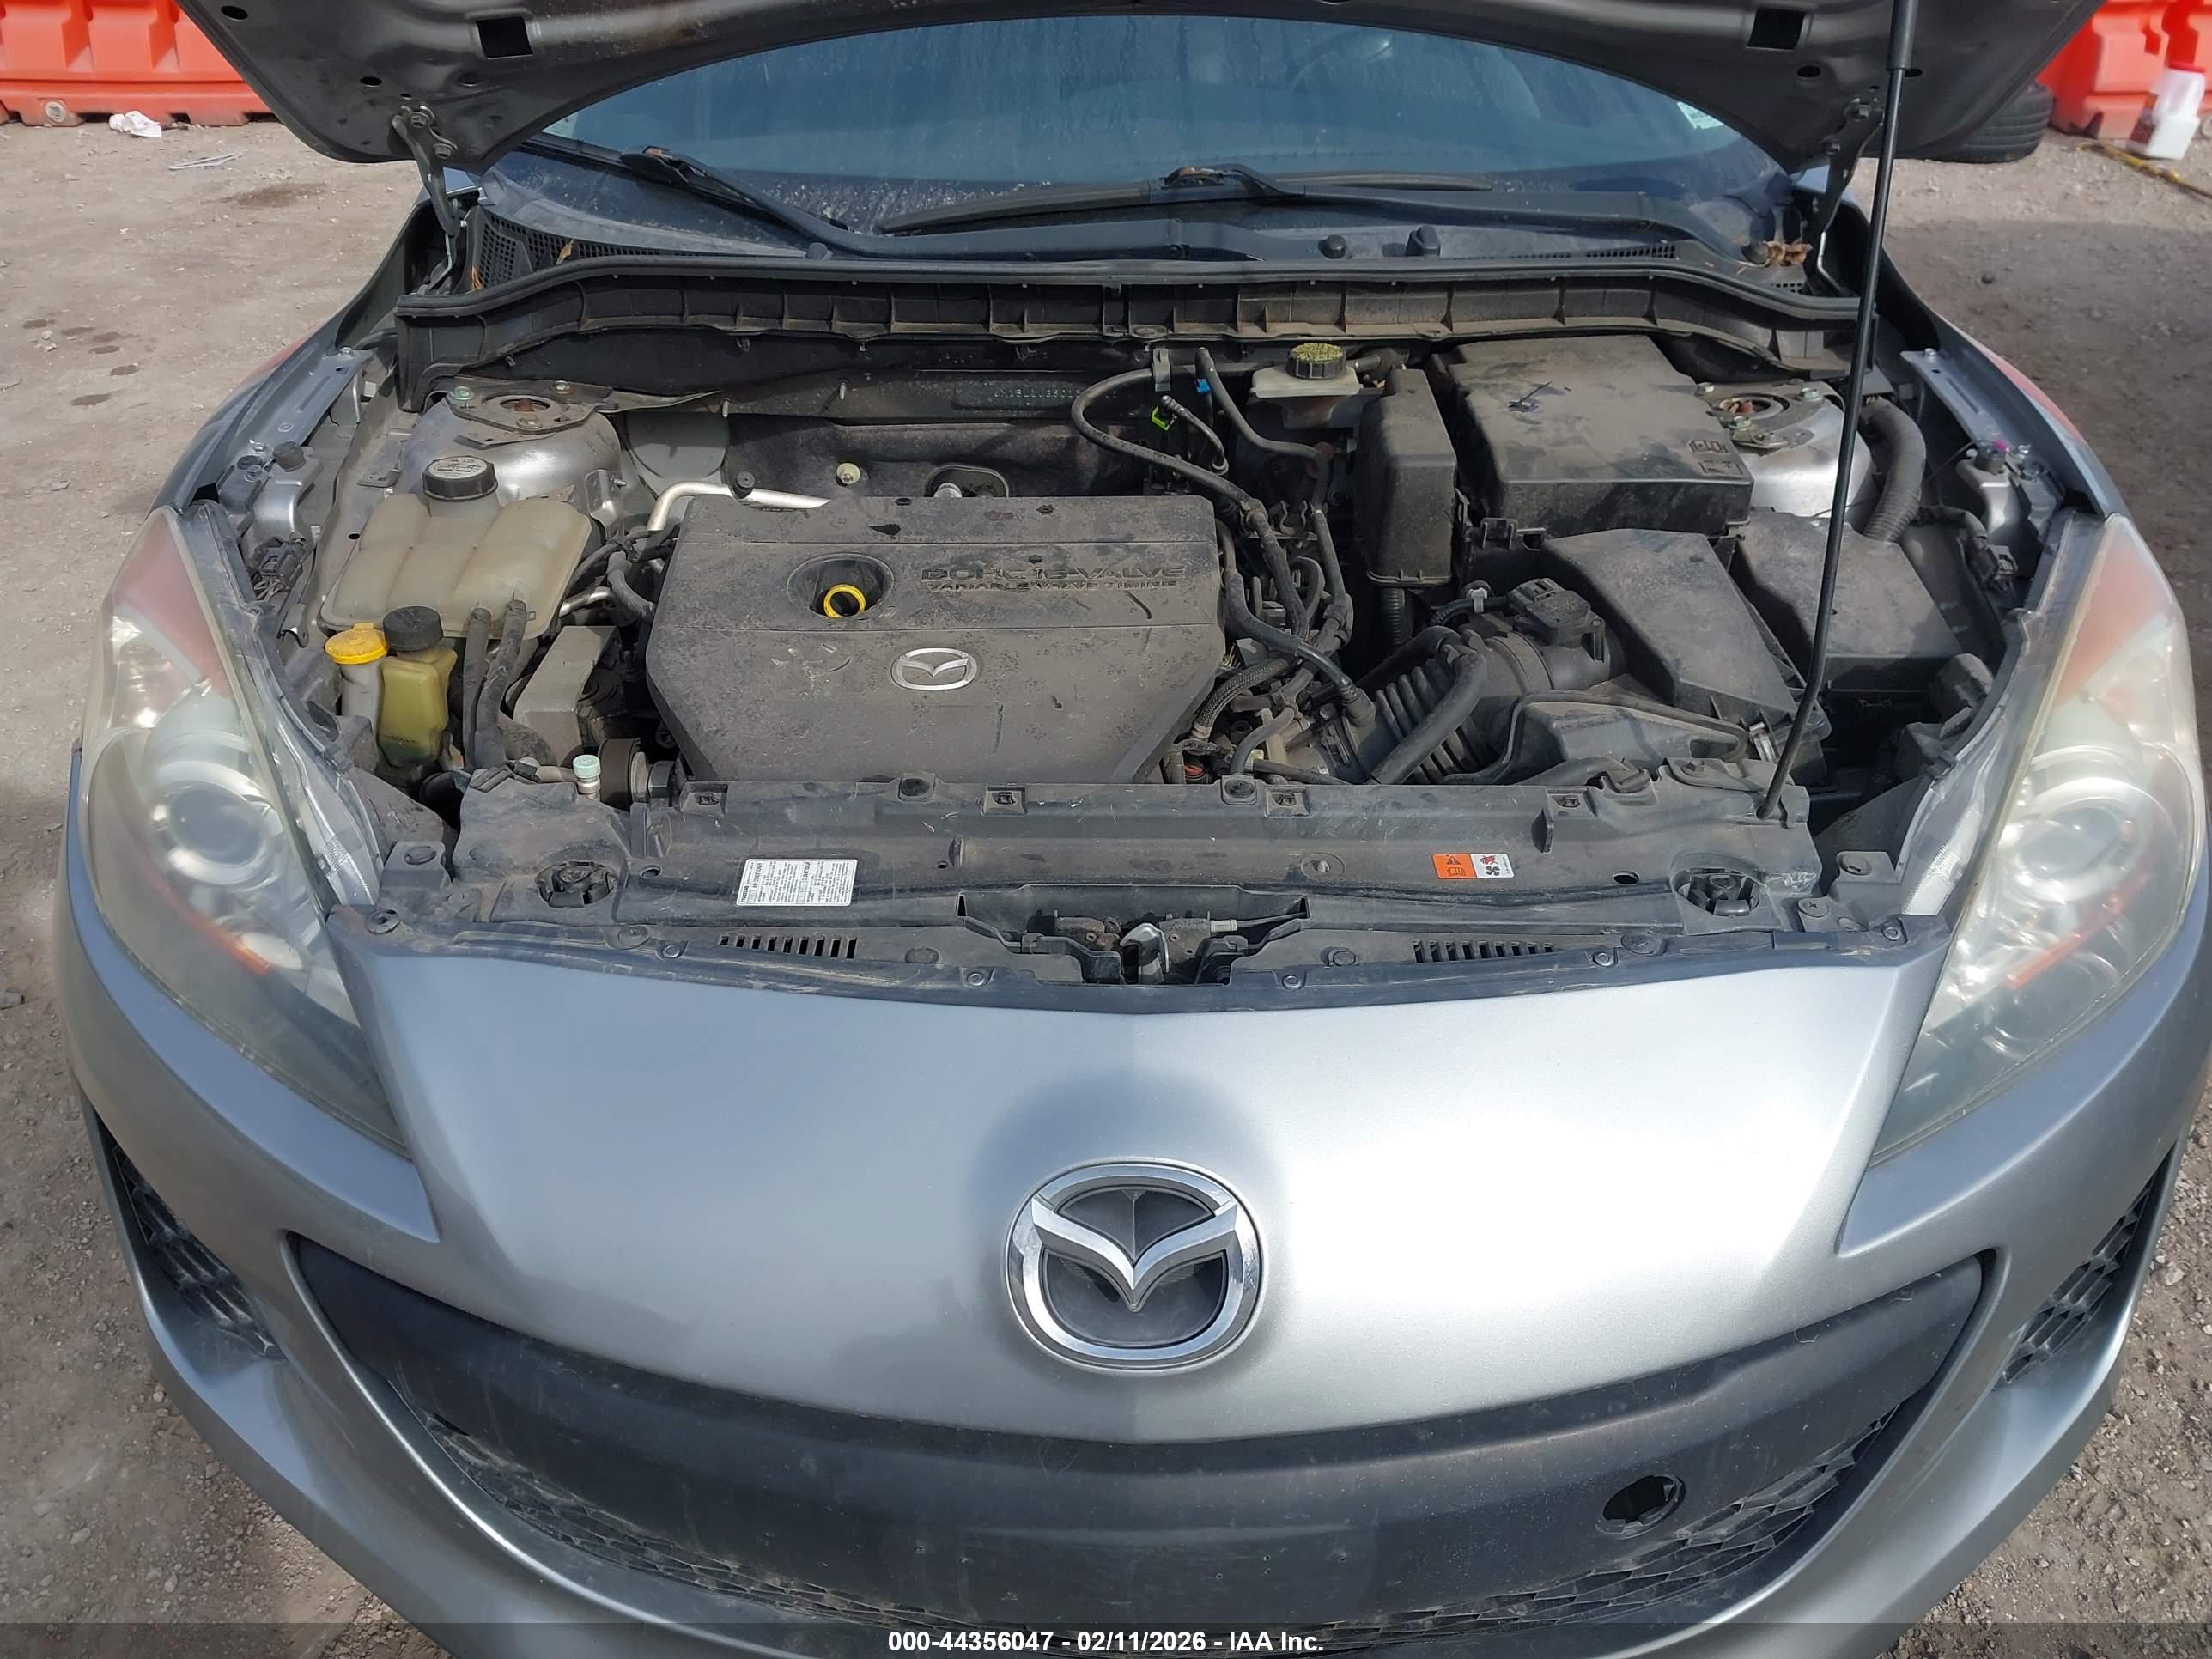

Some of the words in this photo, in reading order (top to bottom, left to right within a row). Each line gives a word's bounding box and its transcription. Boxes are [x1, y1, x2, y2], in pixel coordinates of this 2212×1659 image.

[921, 568, 1027, 581] DOHC
[1033, 566, 1185, 580] 16-VALVE
[1033, 580, 1101, 591] VALVE
